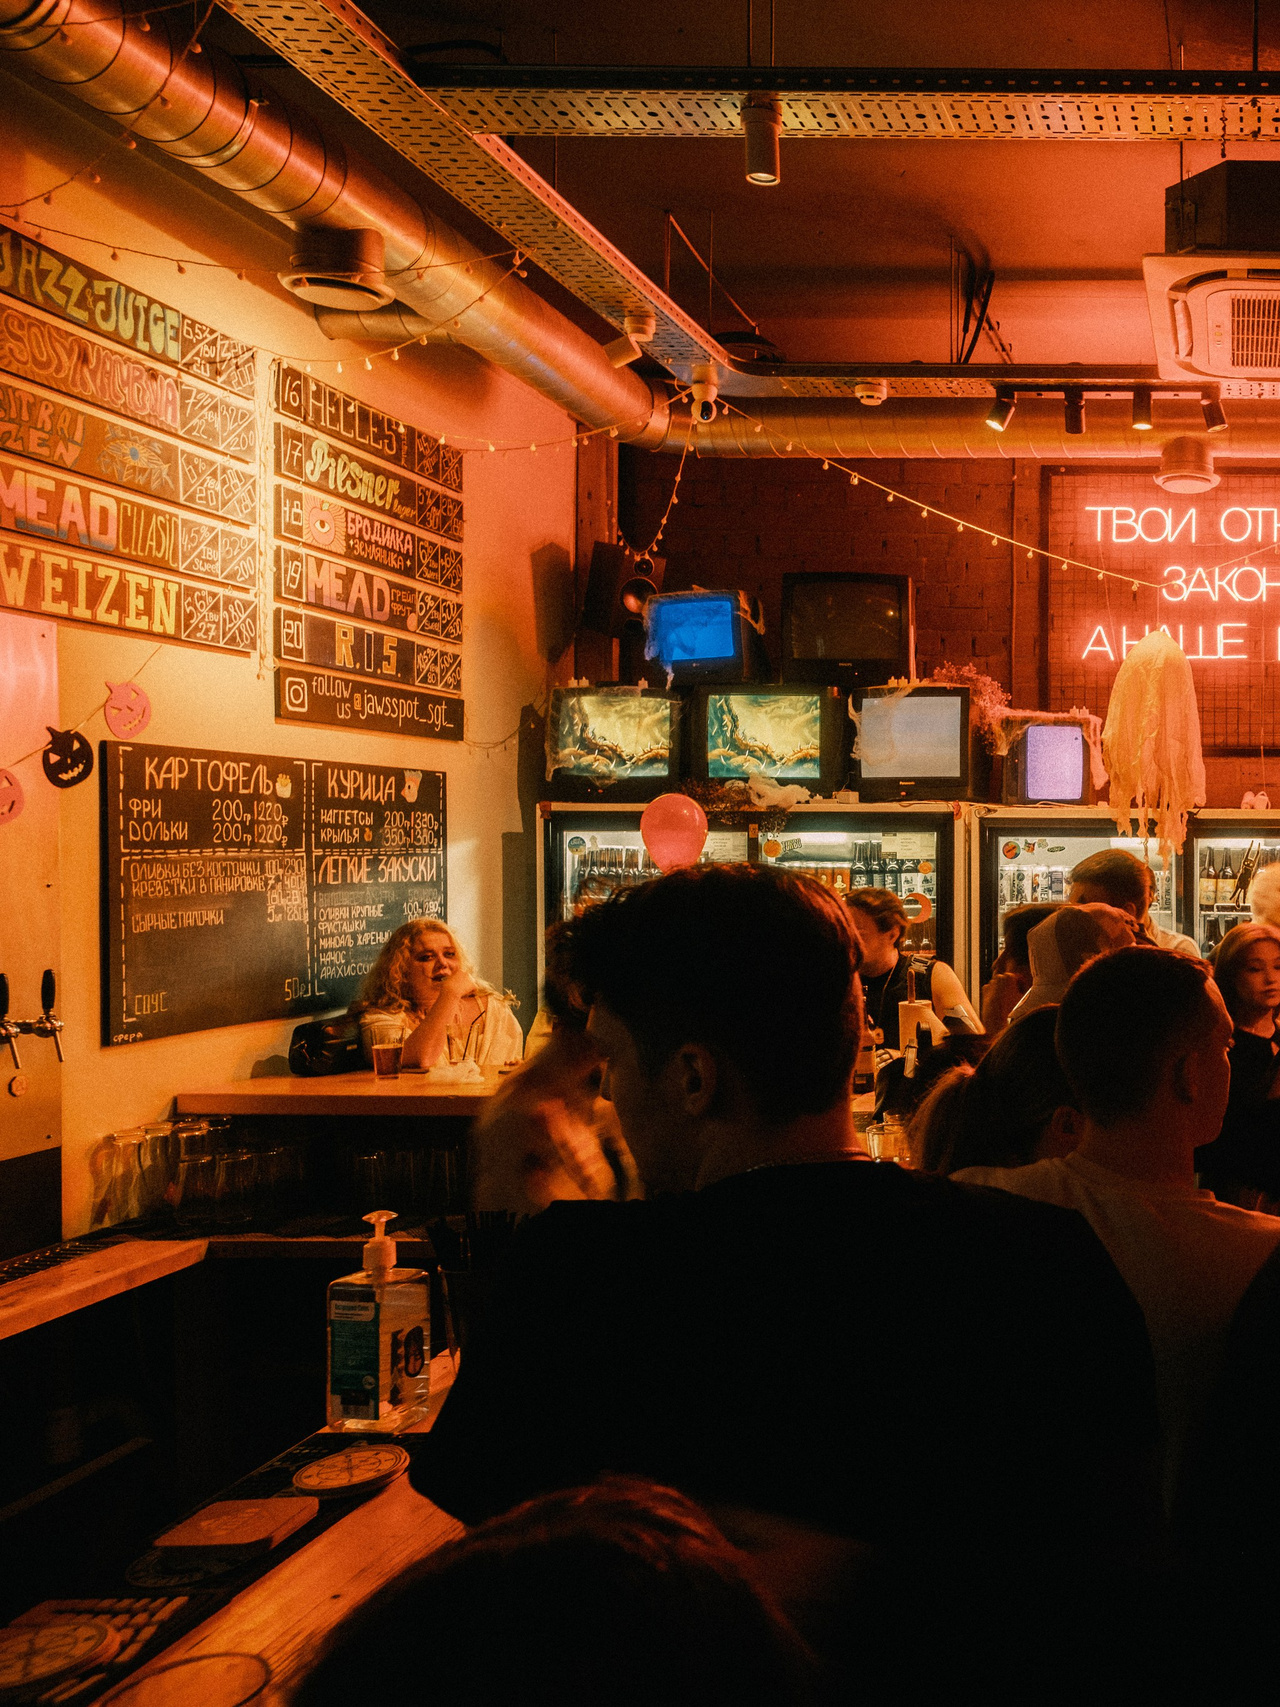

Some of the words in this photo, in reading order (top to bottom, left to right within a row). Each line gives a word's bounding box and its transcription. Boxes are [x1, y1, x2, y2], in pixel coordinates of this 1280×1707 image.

[0, 232, 88, 323] JAZZ
[94, 280, 180, 361] JUICE
[199, 344, 216, 359] IBU
[284, 376, 301, 407] 16
[286, 439, 302, 466] 17
[305, 439, 400, 509] Pilsner
[0, 469, 118, 551] MEAD
[283, 499, 302, 526] 18
[347, 511, 413, 555] БРОДИЛКА
[1085, 506, 1196, 543] ТВОИ
[201, 547, 219, 560] IBU
[0, 544, 179, 634] WEIZEN
[287, 560, 301, 589] 19
[307, 556, 390, 621] MEAD
[197, 623, 216, 639] 27
[284, 620, 302, 649] 20
[312, 675, 352, 699] follow
[337, 702, 351, 719] us
[145, 756, 273, 795] КАРТОФЕЛЬ
[328, 768, 396, 805] КУРИЦА
[129, 798, 162, 818] ФРИ
[320, 809, 374, 826] НАГГЕТСЫ
[320, 828, 360, 844] КРЫЛЬЯ
[131, 862, 180, 882] ОЛИВКИ
[183, 860, 205, 878] БЕЗ
[206, 861, 260, 877] КОСТОЧКИ
[318, 855, 373, 885] ЛЕГКИЕ
[378, 855, 437, 883] ЗАКУСКИ
[132, 878, 196, 897] КРЕВЕТКИ
[210, 875, 265, 893] ПАНИРОВКЕ
[132, 911, 178, 933] СЫРНЫЕ
[179, 909, 224, 928] ПАЛОЧКИ
[319, 906, 350, 922] ОЛИВКИ
[351, 903, 384, 918] КРУПНЫЕ
[318, 919, 366, 937] ФИСТАШКИ
[319, 951, 346, 967] НАЧОС
[135, 992, 168, 1015] СОУС
